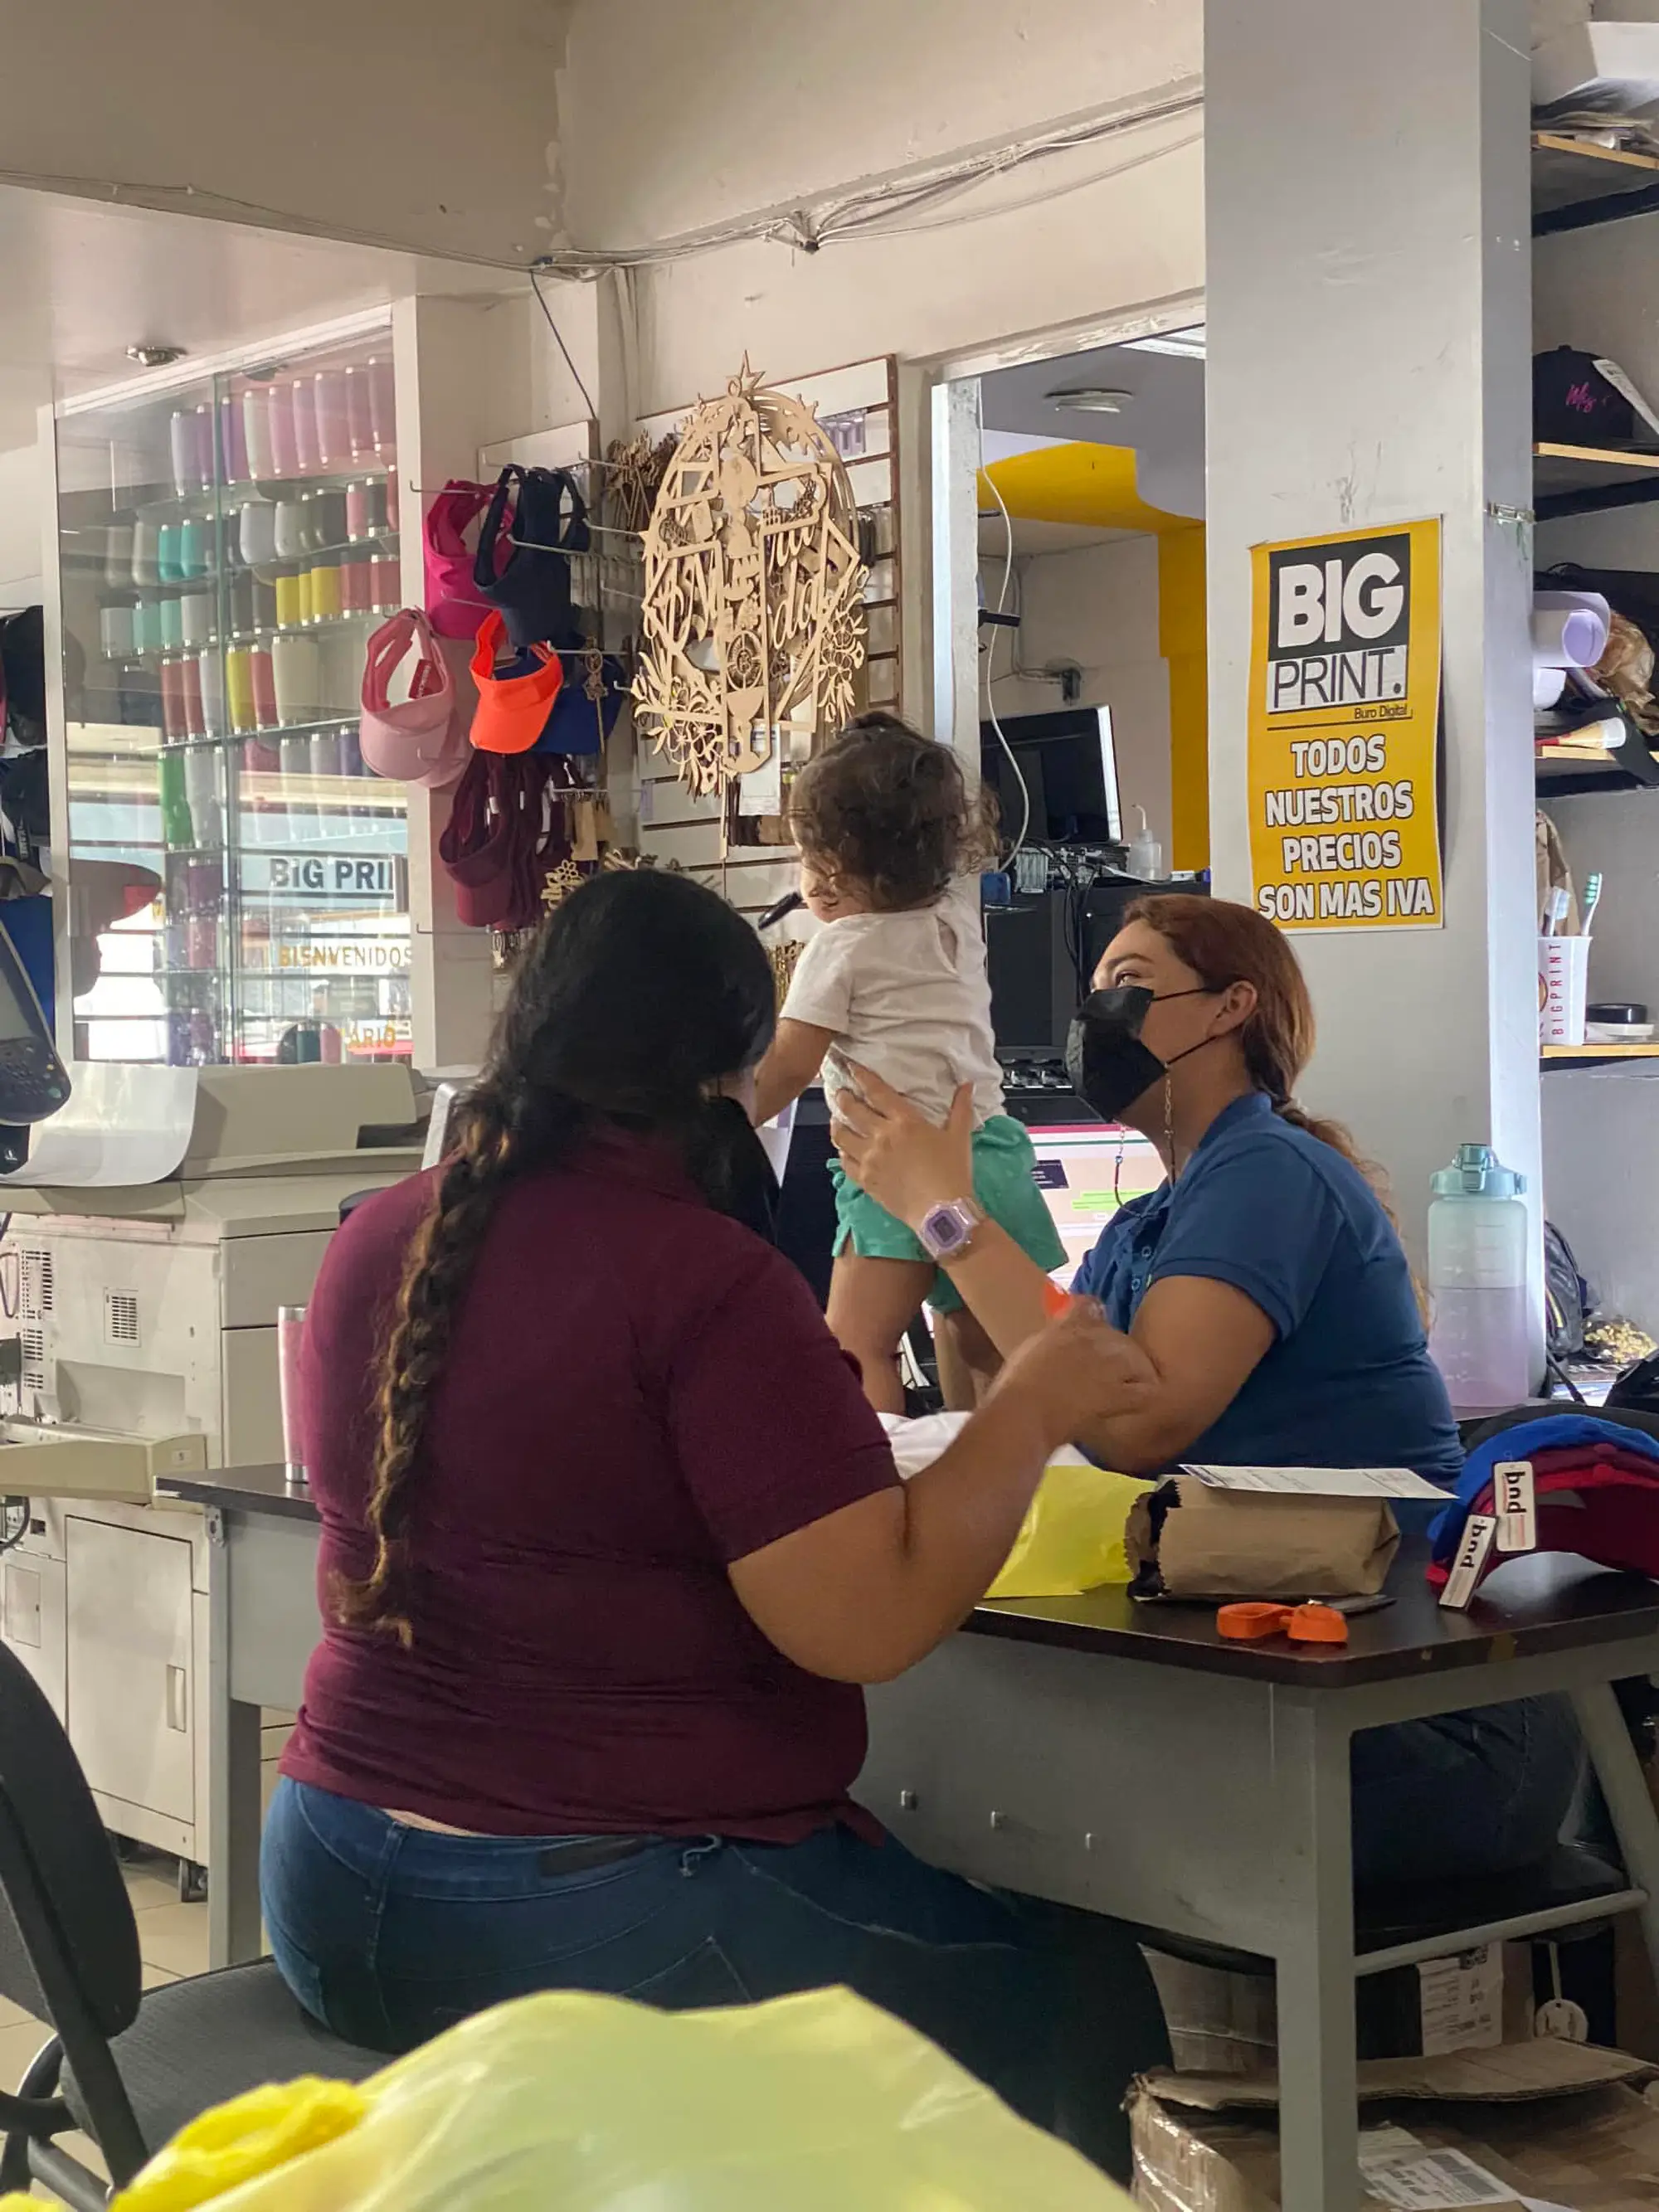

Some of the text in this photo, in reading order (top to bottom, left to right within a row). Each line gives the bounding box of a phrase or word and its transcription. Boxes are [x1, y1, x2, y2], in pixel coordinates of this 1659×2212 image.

[1277, 552, 1404, 648] BIG
[1354, 703, 1408, 720] Buro Digital
[1291, 735, 1385, 778] TODOS
[1265, 782, 1413, 827] NUESTROS
[270, 858, 324, 889] BIG
[1282, 831, 1401, 873] PRECIOS
[1258, 878, 1434, 921] SON MAS IVA
